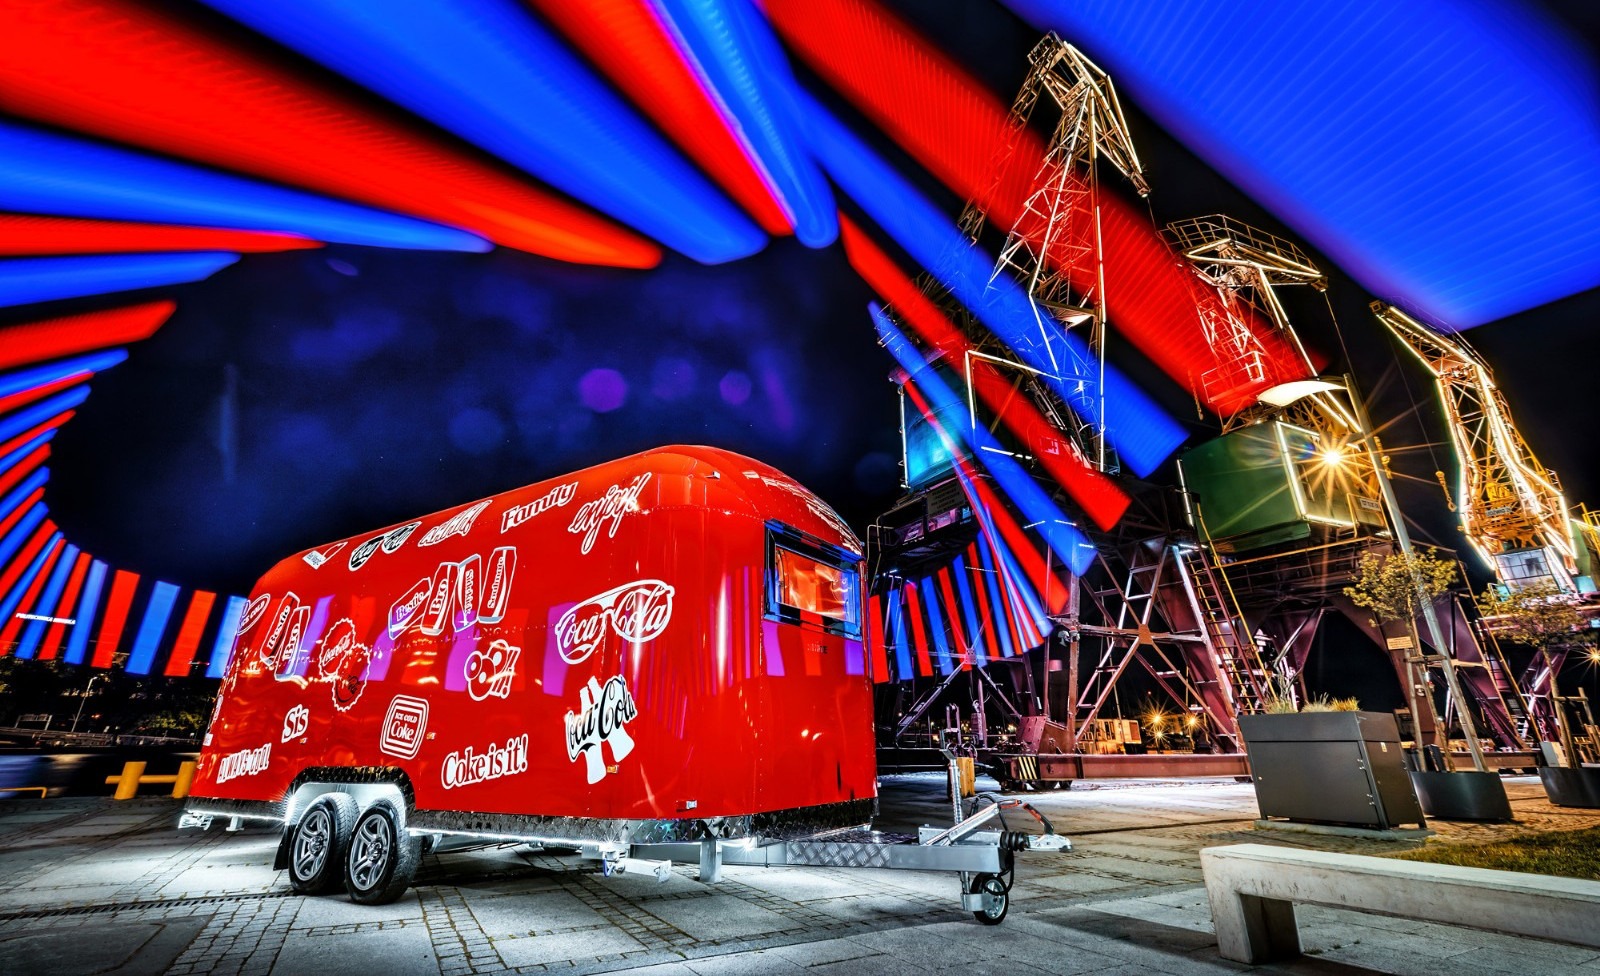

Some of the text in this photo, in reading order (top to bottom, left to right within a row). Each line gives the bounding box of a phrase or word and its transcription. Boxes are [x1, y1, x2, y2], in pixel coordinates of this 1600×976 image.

[501, 481, 578, 534] Family
[428, 578, 448, 615] Bro
[487, 556, 504, 608] Soulmate
[396, 592, 424, 622] Bestie
[266, 605, 290, 649] Bestie
[282, 623, 300, 661] Bro
[281, 704, 309, 743] Sis
[391, 720, 415, 741] Coke
[395, 712, 418, 723] ICE COLD
[442, 734, 528, 789] Coke is it!
